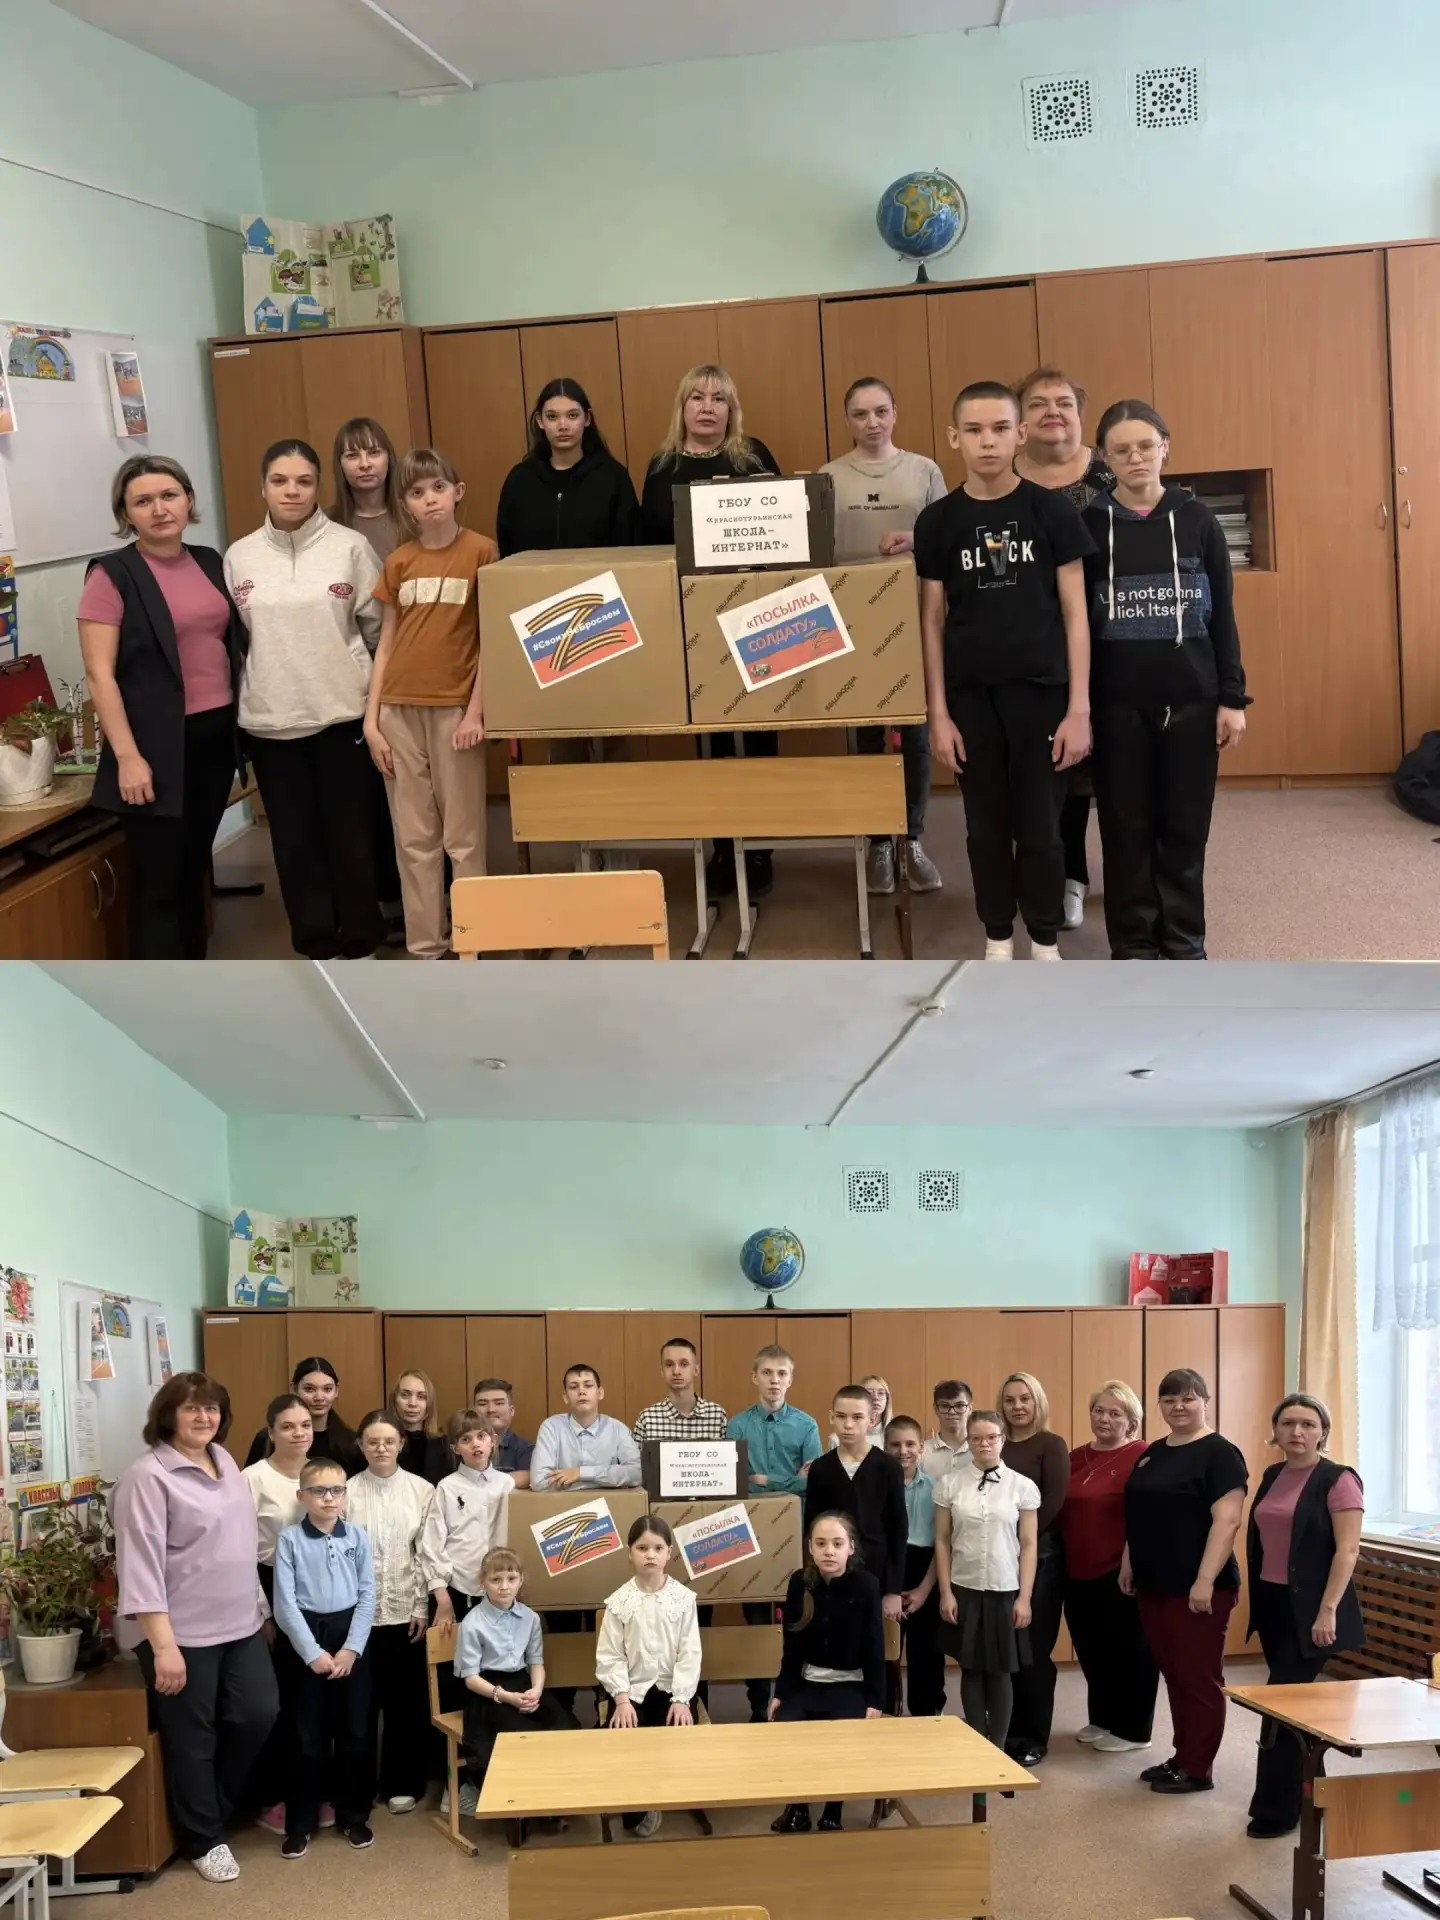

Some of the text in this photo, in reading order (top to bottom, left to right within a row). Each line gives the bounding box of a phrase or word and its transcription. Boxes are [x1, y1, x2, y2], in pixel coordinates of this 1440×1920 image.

[718, 496, 778, 508] ГБОУ СО
[723, 526, 775, 538] ШКОЛА-
[711, 540, 789, 553] ИНТЕРНАТ»
[868, 569, 902, 605] wildberries
[1128, 586, 1156, 600] not
[746, 592, 820, 629] «ПОСЫЛКА
[1117, 604, 1145, 619] lick
[747, 617, 818, 653] СОЛДАТУ»
[872, 620, 907, 658] wildberries
